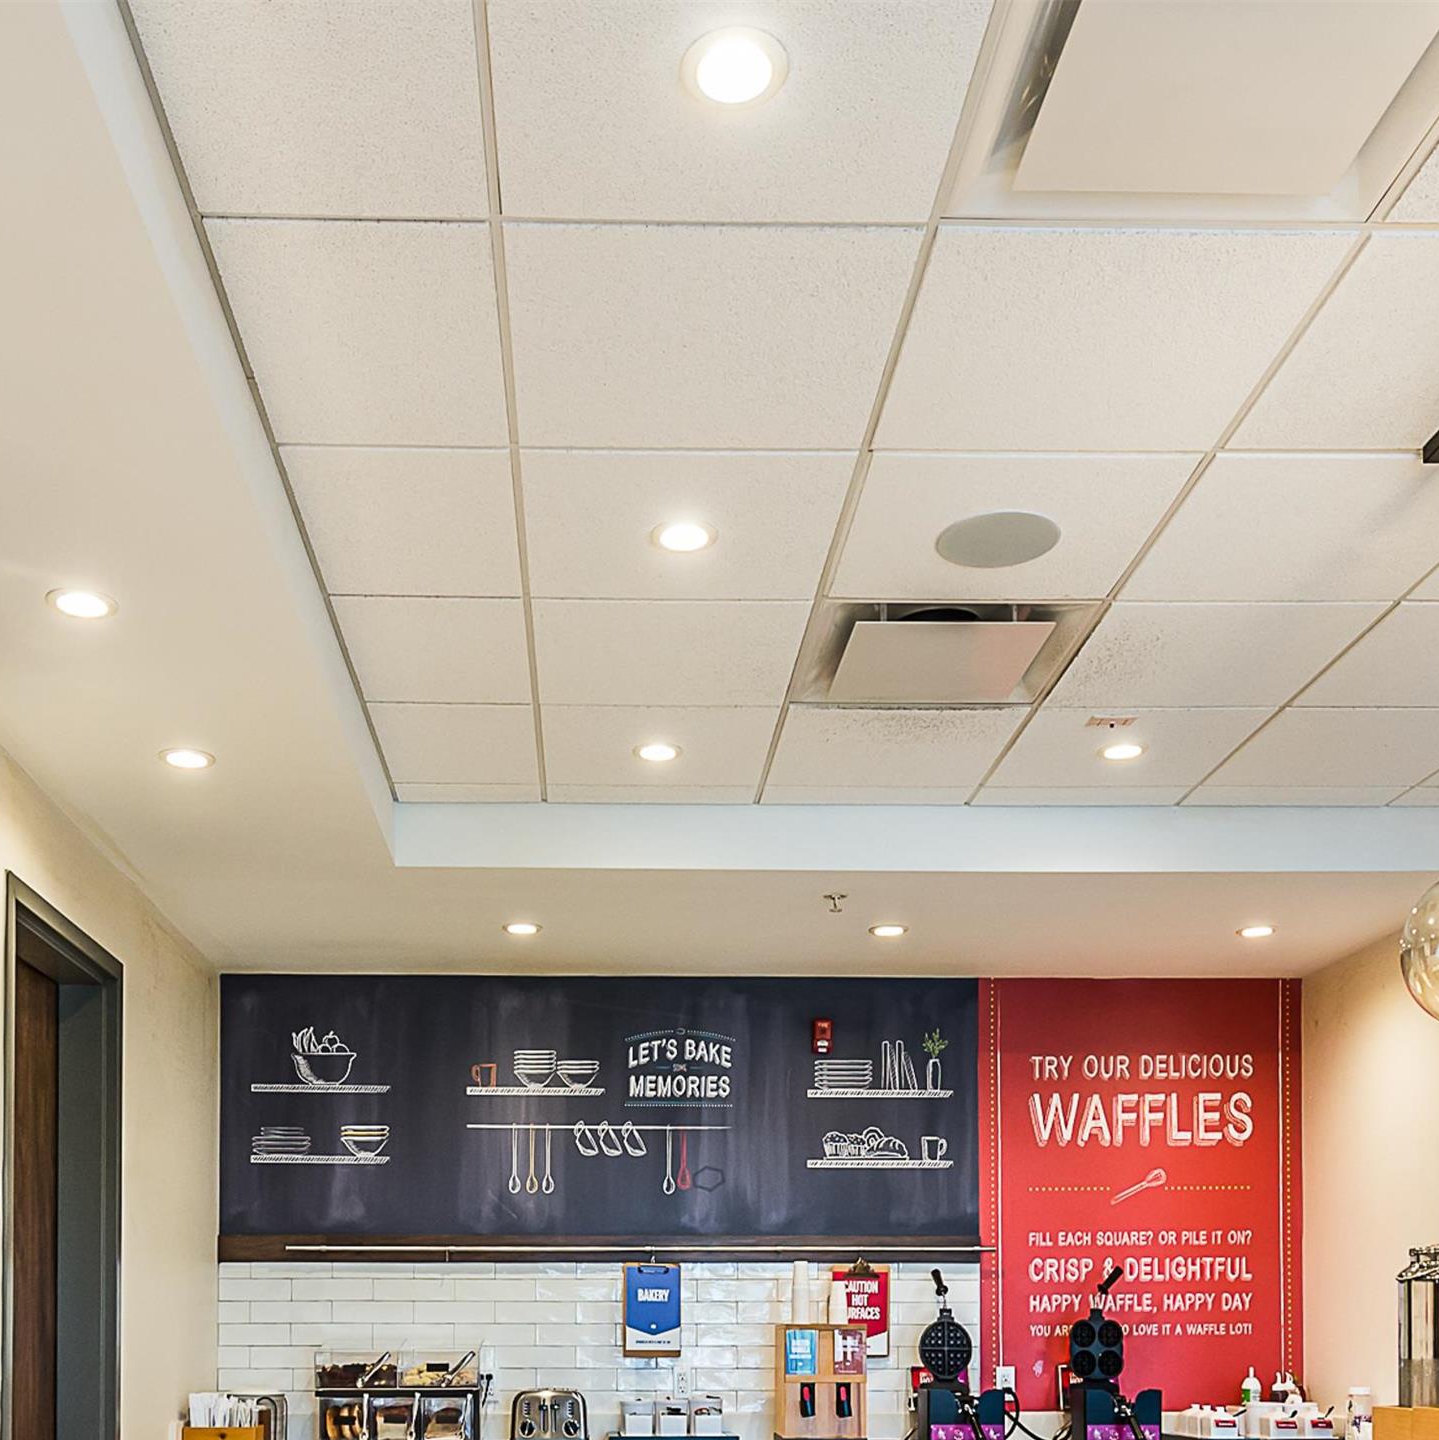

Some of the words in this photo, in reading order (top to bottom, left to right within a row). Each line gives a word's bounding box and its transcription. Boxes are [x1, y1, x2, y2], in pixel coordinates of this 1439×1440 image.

[628, 1038, 678, 1068] LET'S
[684, 1039, 732, 1068] BAKE
[1029, 1055, 1073, 1081] TRY
[1082, 1054, 1130, 1081] OUR
[1139, 1053, 1254, 1081] DELICIOUS
[629, 1075, 730, 1098] MEMORIES
[1028, 1091, 1254, 1147] WAFFLES
[1028, 1231, 1053, 1247] FILL
[1058, 1231, 1091, 1246] EACH
[1096, 1231, 1153, 1247] SQUARE?
[1159, 1231, 1177, 1246] OR
[1181, 1231, 1207, 1245] PILE
[1212, 1231, 1223, 1245] IT
[1227, 1230, 1252, 1245] ON?
[1028, 1257, 1093, 1283] CRISP
[1124, 1256, 1253, 1282] DELIGHTFUL
[637, 1288, 670, 1302] BAKERY
[852, 1294, 868, 1306] HOT
[1029, 1294, 1082, 1313] HAPPY
[1088, 1293, 1158, 1314] WAFFLE,
[1163, 1293, 1215, 1312] HAPPY
[1221, 1292, 1252, 1312] DAY
[848, 1307, 881, 1320] URFACES
[1029, 1325, 1051, 1336] YOU
[1133, 1324, 1158, 1335] LOVE
[1162, 1324, 1171, 1335] IT
[1174, 1324, 1182, 1335] A
[1186, 1323, 1226, 1335] WAFFLE
[1229, 1323, 1252, 1335] LOT!
